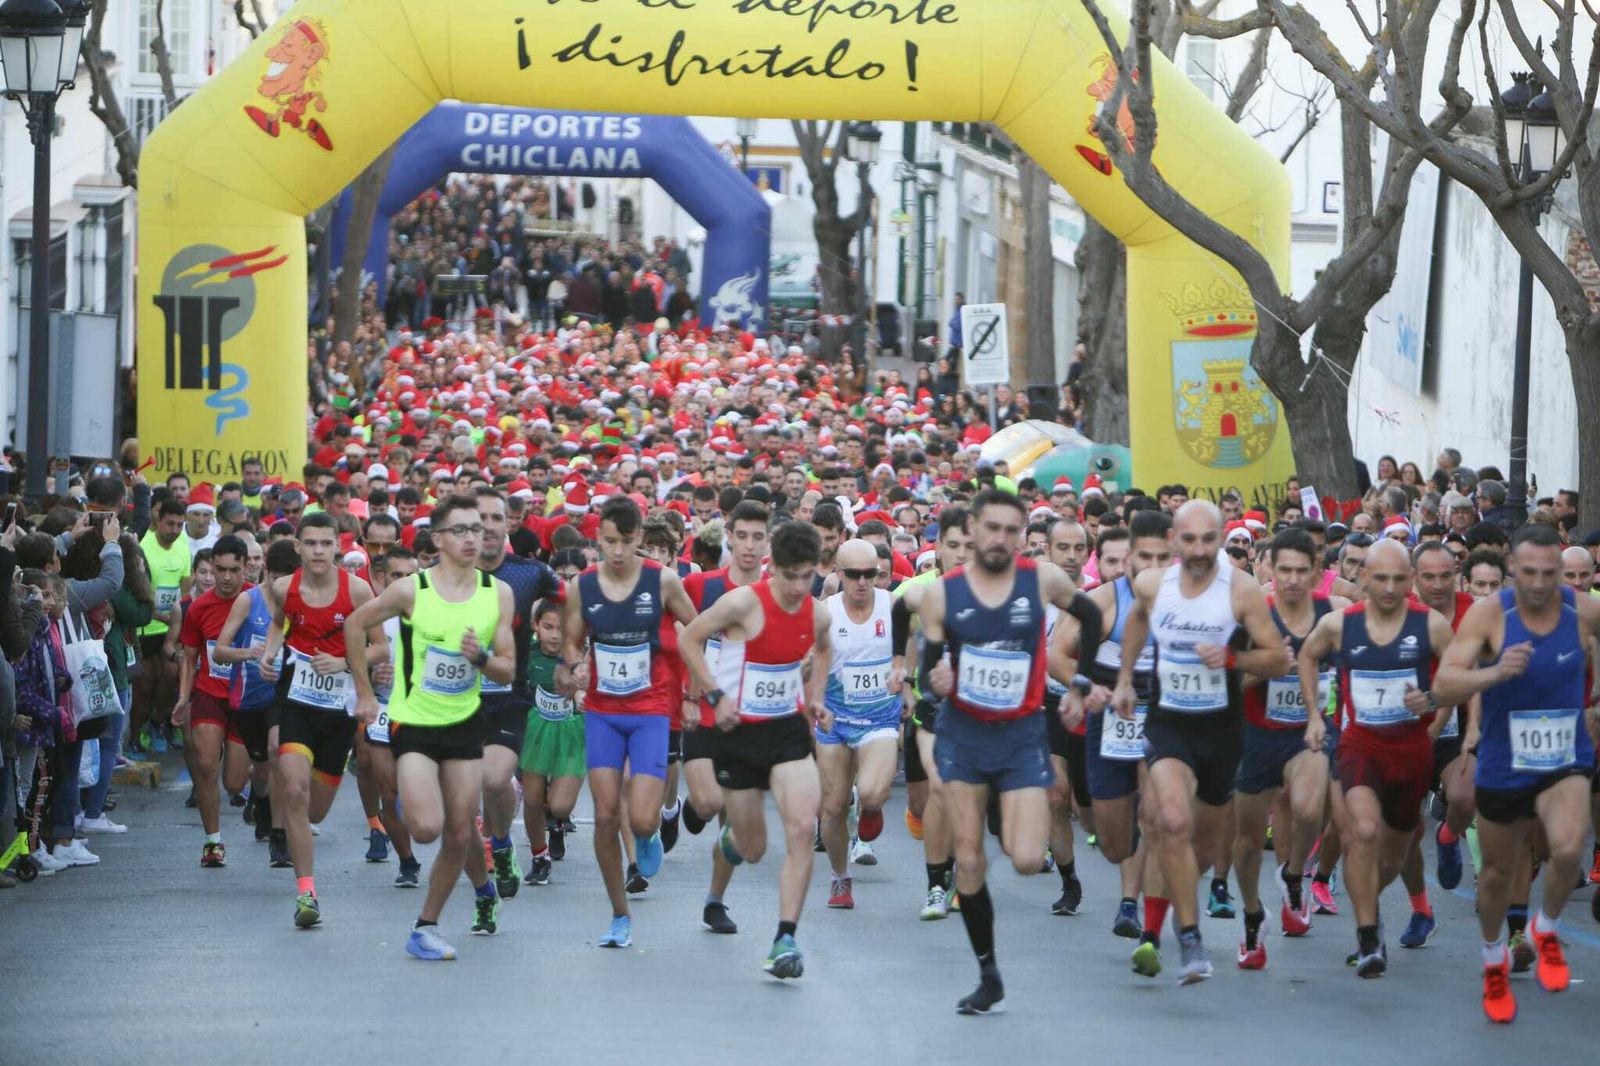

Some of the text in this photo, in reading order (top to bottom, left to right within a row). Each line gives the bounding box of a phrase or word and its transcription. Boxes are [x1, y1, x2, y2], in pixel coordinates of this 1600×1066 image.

[464, 112, 642, 140] DEPORTES
[461, 143, 642, 169] CHICLANA
[435, 662, 466, 680] 695
[608, 661, 628, 678] 74
[967, 665, 1012, 689] 1169
[300, 669, 334, 691] 1100
[755, 680, 786, 698] 694
[853, 673, 879, 689] 781
[1170, 672, 1202, 690] 971
[540, 698, 559, 711] 1076
[1275, 690, 1305, 706] 106
[1375, 689, 1385, 705] 7
[1115, 721, 1146, 740] 932
[1520, 729, 1562, 749] 1011
